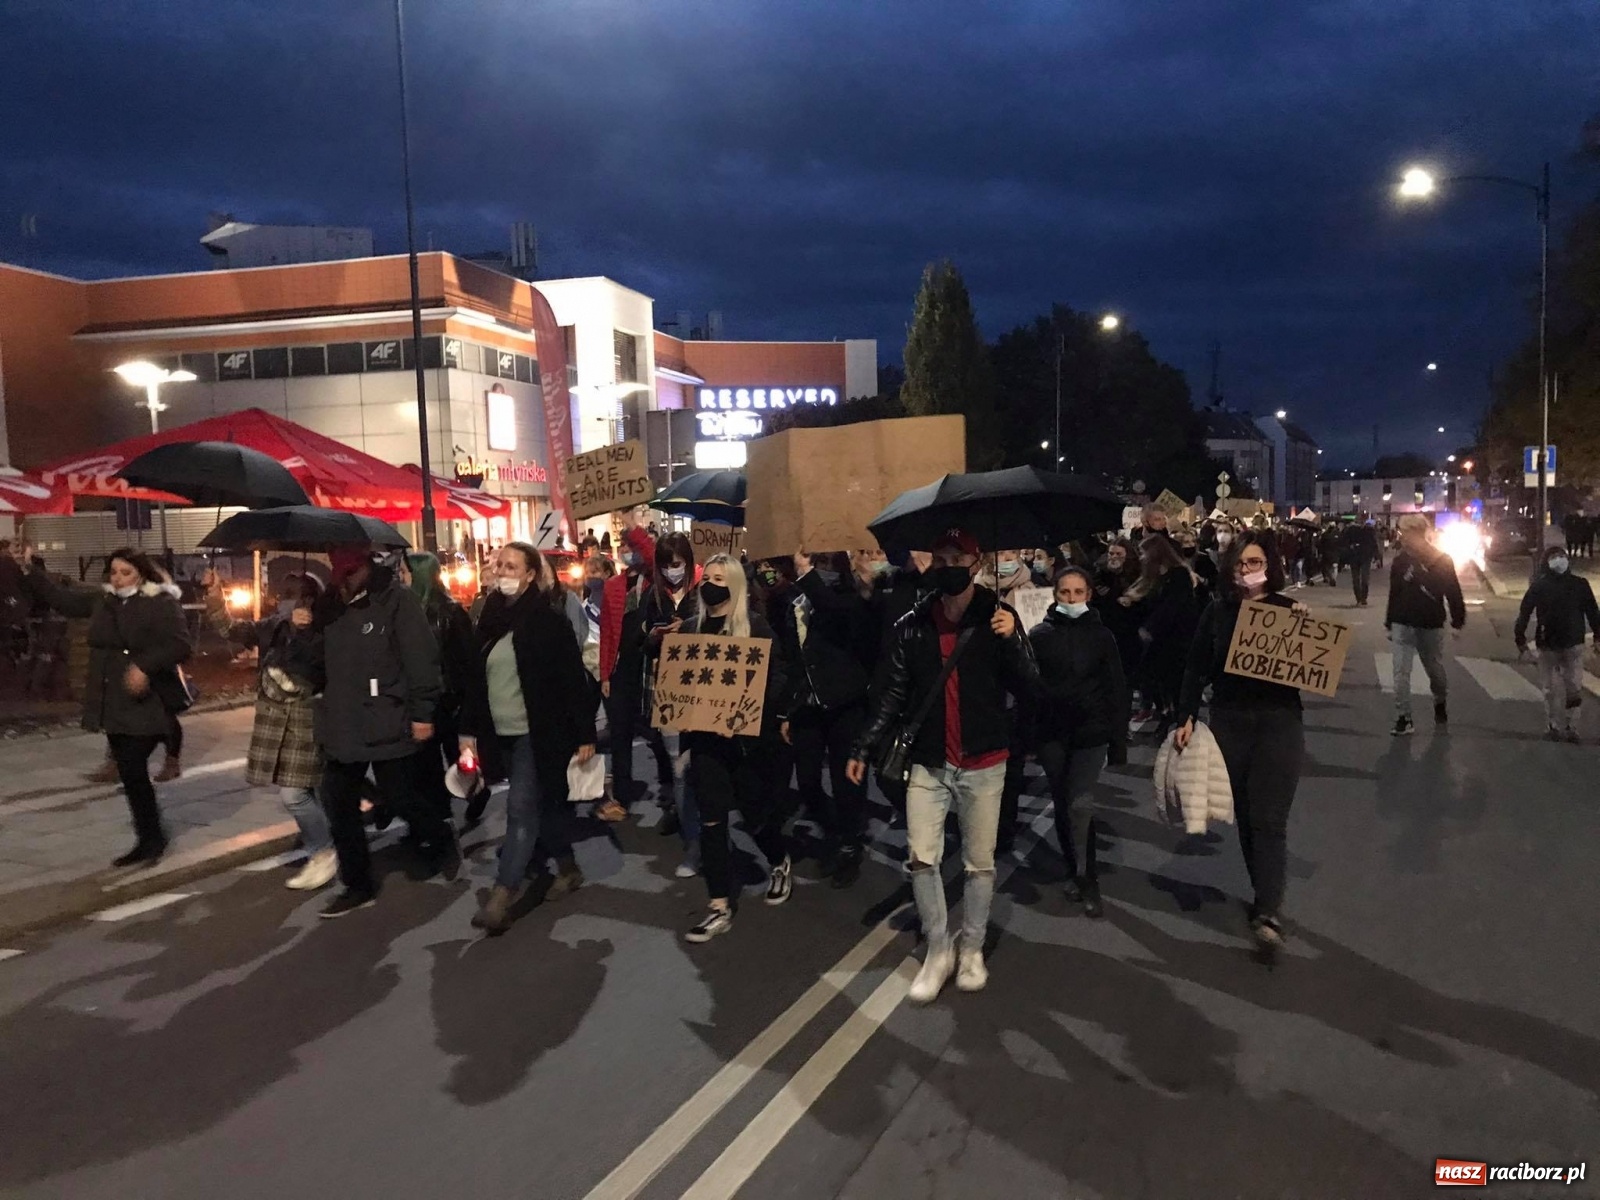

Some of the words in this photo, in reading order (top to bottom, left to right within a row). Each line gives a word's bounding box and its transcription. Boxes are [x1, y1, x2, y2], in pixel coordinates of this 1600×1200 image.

[370, 342, 397, 359] 4F
[446, 340, 461, 356] 4F
[223, 353, 248, 369] 4F
[499, 354, 513, 369] 4F
[700, 388, 837, 409] RESERVED
[566, 453, 605, 474] REAL
[607, 447, 635, 463] MEN
[583, 466, 620, 489] ARE
[570, 477, 650, 511] FEMINISTS
[1248, 607, 1277, 628] TO
[1281, 613, 1348, 645] JEST
[1238, 630, 1304, 661] WOJNA
[1309, 646, 1330, 667] Z
[1230, 649, 1330, 690] KOBIETAMI
